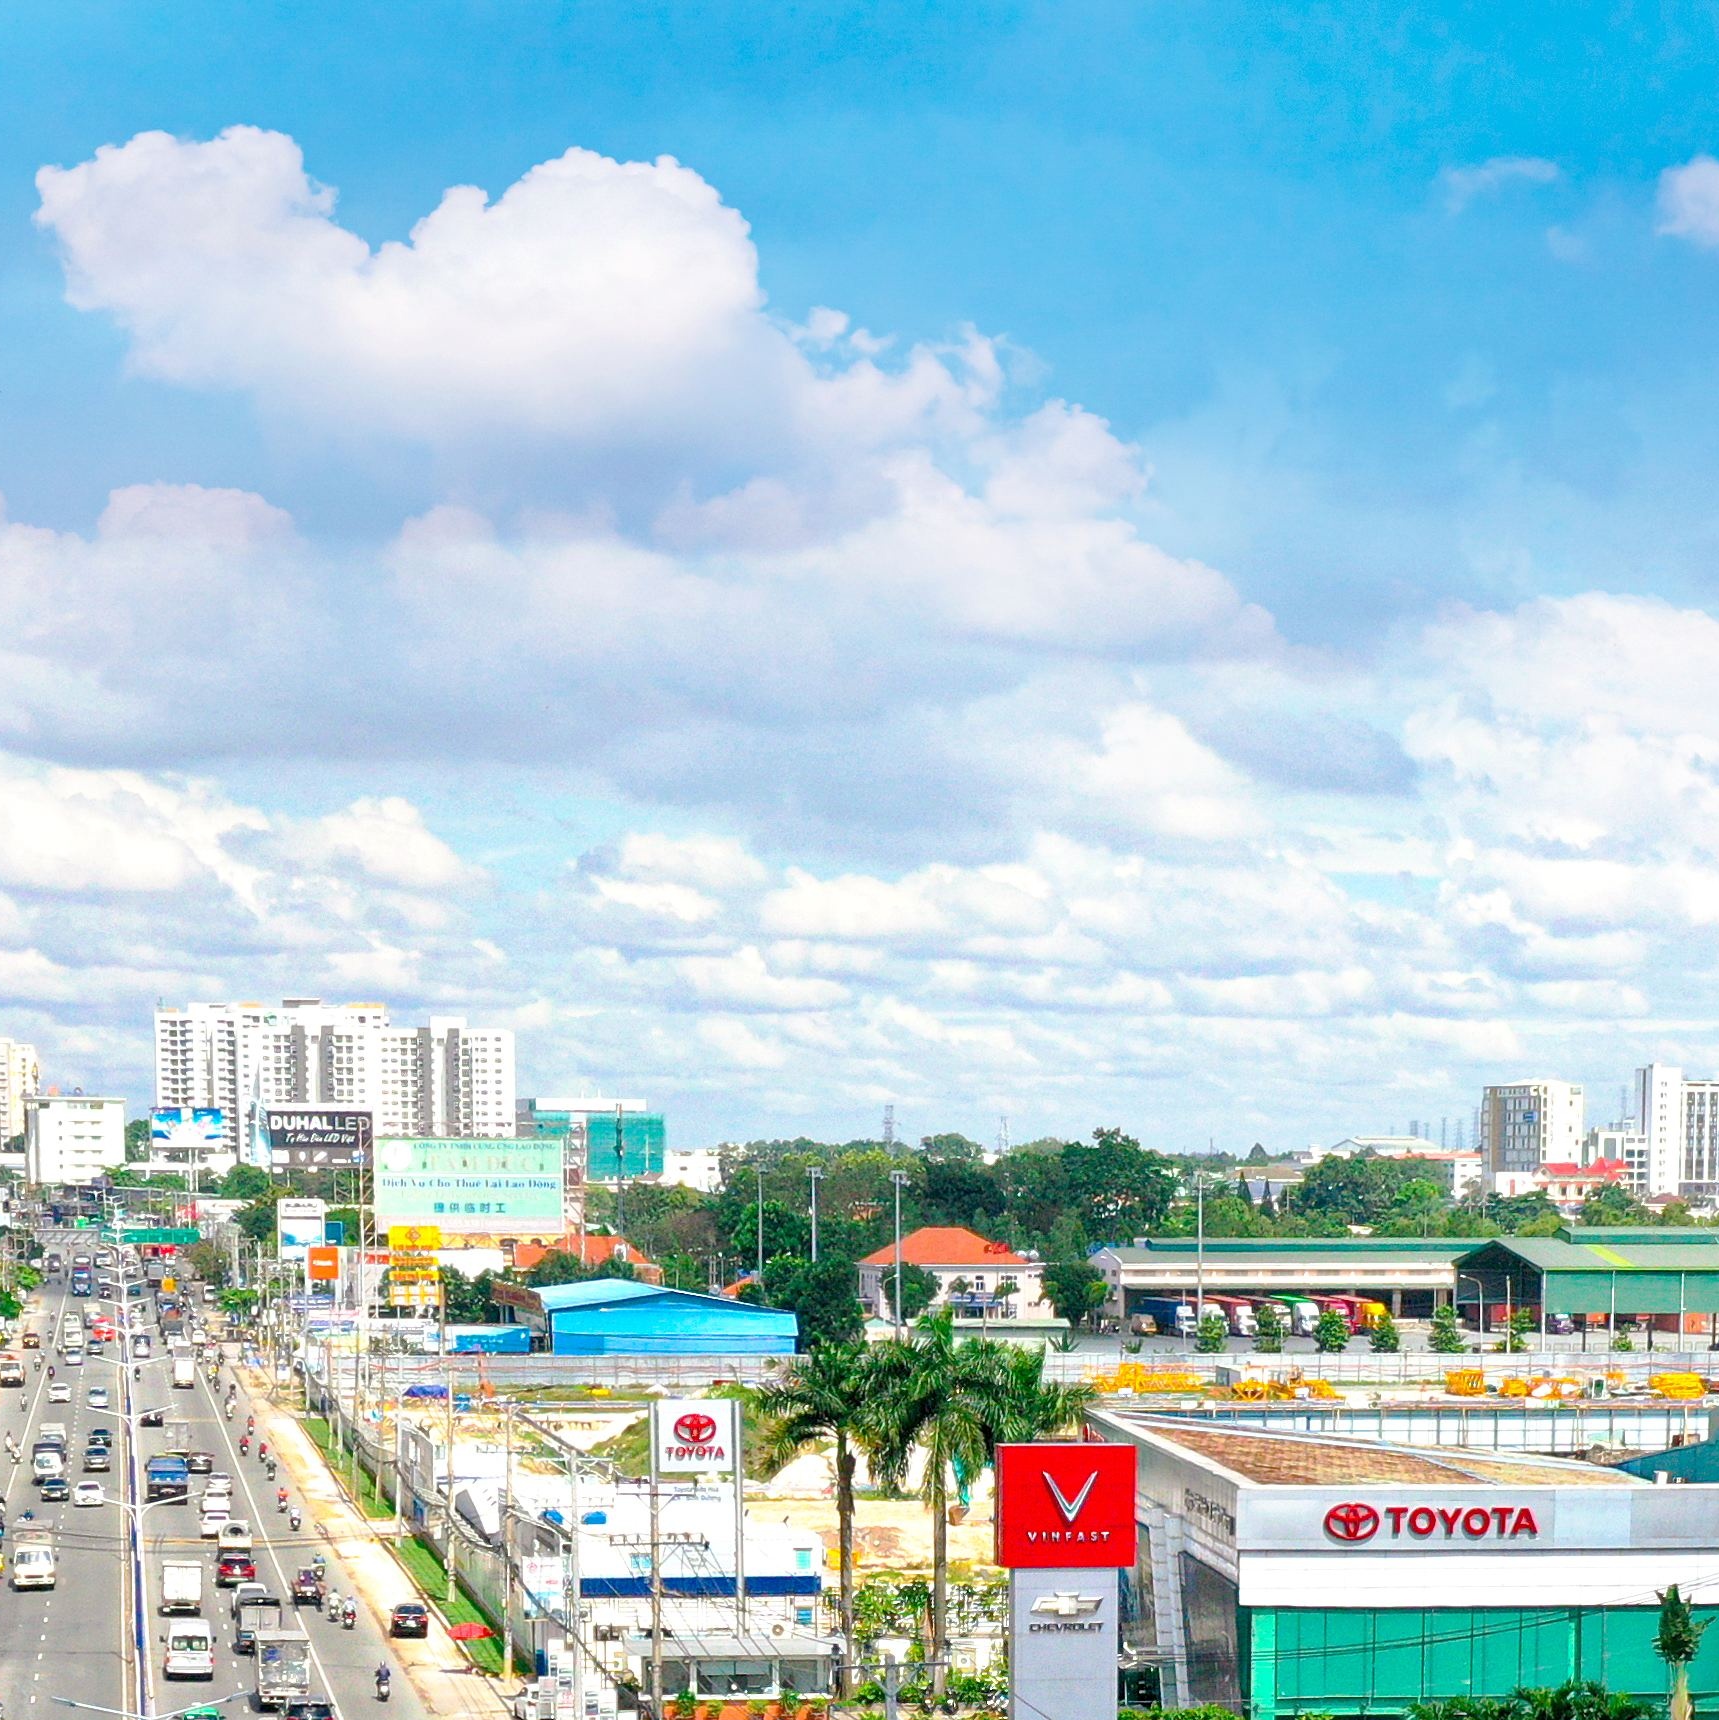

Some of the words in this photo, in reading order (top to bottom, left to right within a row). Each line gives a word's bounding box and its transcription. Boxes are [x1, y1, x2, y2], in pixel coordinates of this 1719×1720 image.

[270, 1115, 333, 1130] DUHAL
[334, 1116, 370, 1131] LED
[665, 1446, 725, 1461] TOYOTA
[1385, 1506, 1539, 1538] TOYOTA
[1027, 1531, 1110, 1542] VINFAST
[1029, 1622, 1105, 1633] CHEVROLET
